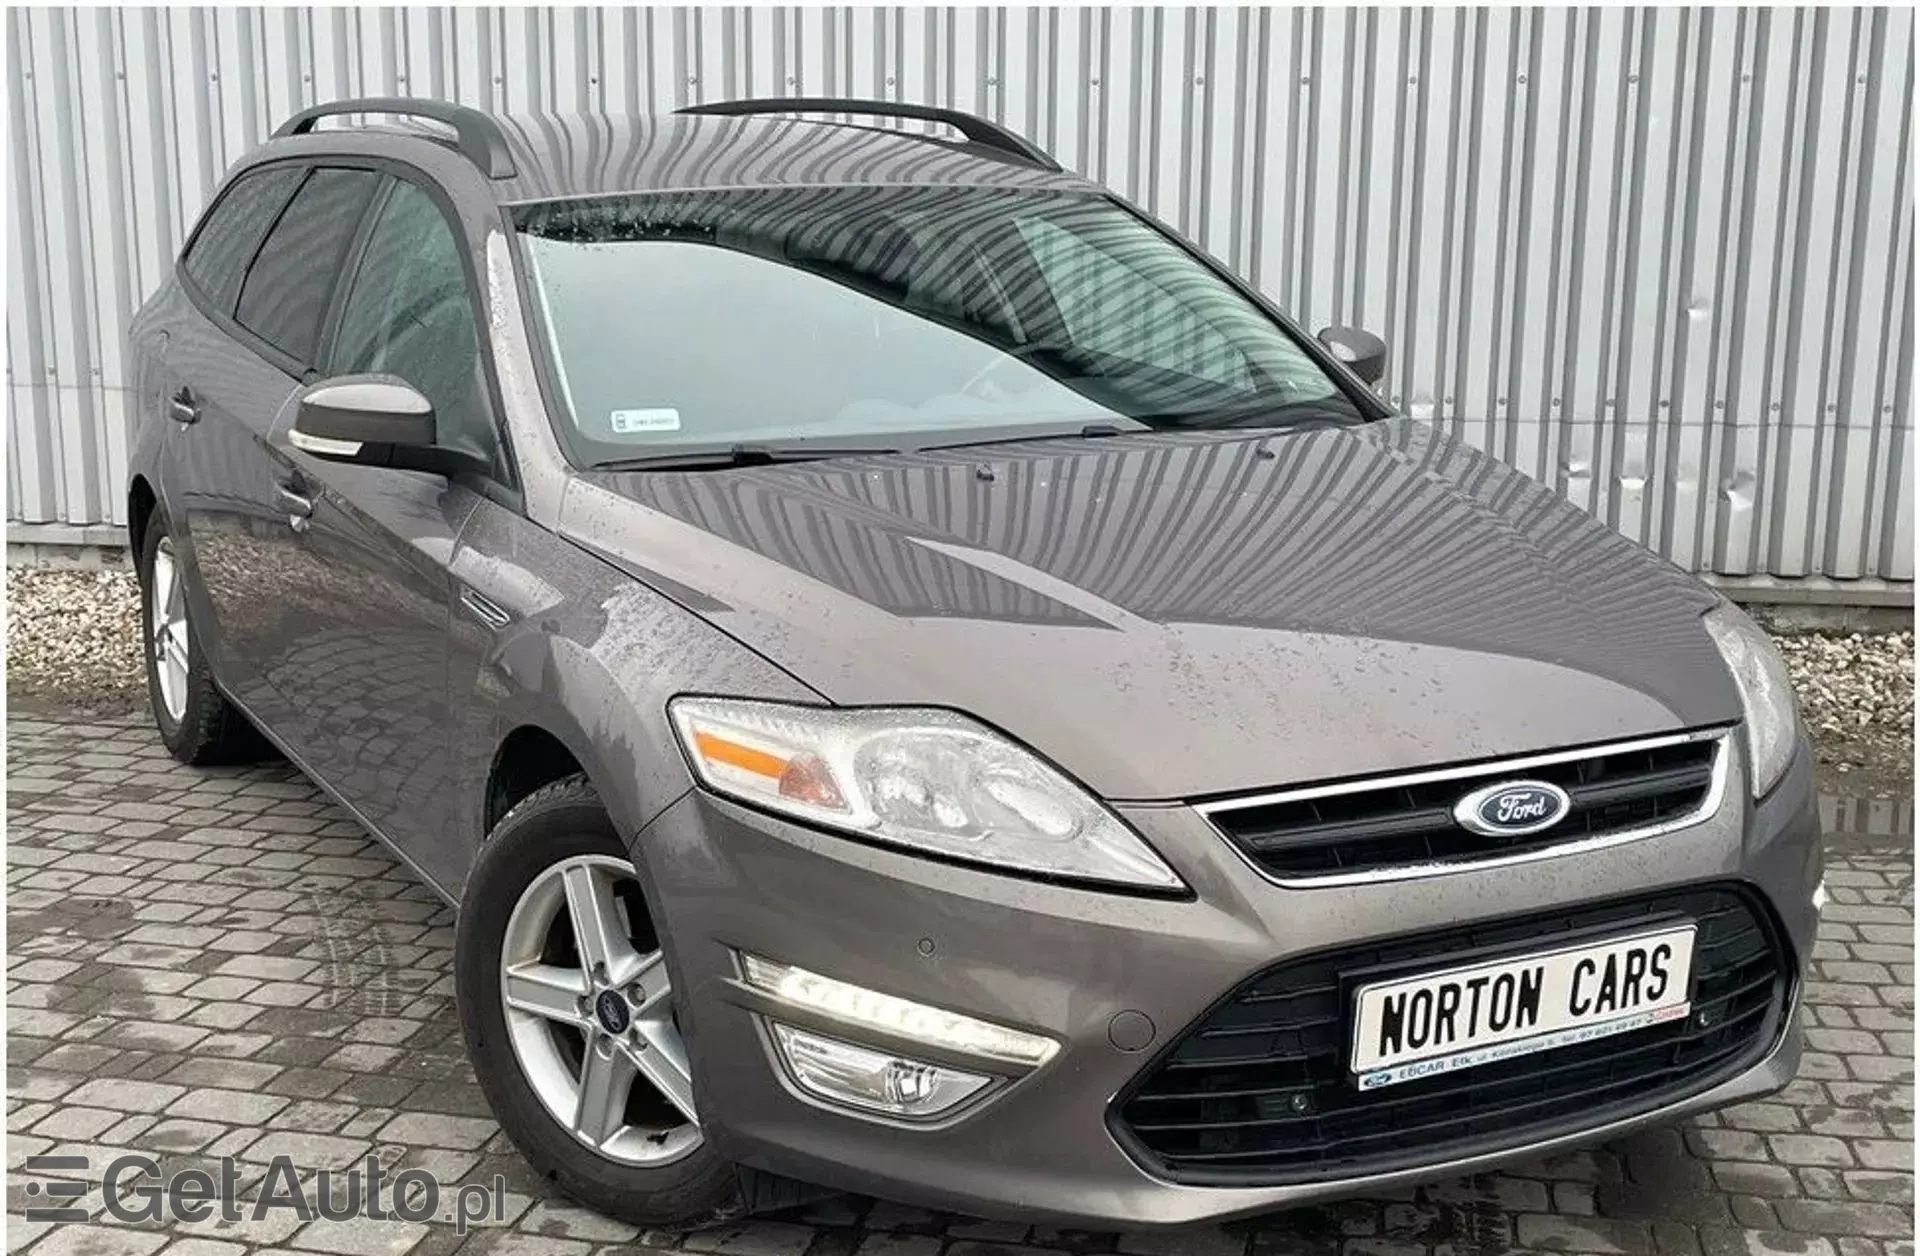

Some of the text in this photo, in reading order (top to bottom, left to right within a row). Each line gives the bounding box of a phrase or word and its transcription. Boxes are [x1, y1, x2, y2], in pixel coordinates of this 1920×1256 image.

[1497, 793, 1547, 822] Ford
[1379, 945, 1671, 1056] NORTON CARS
